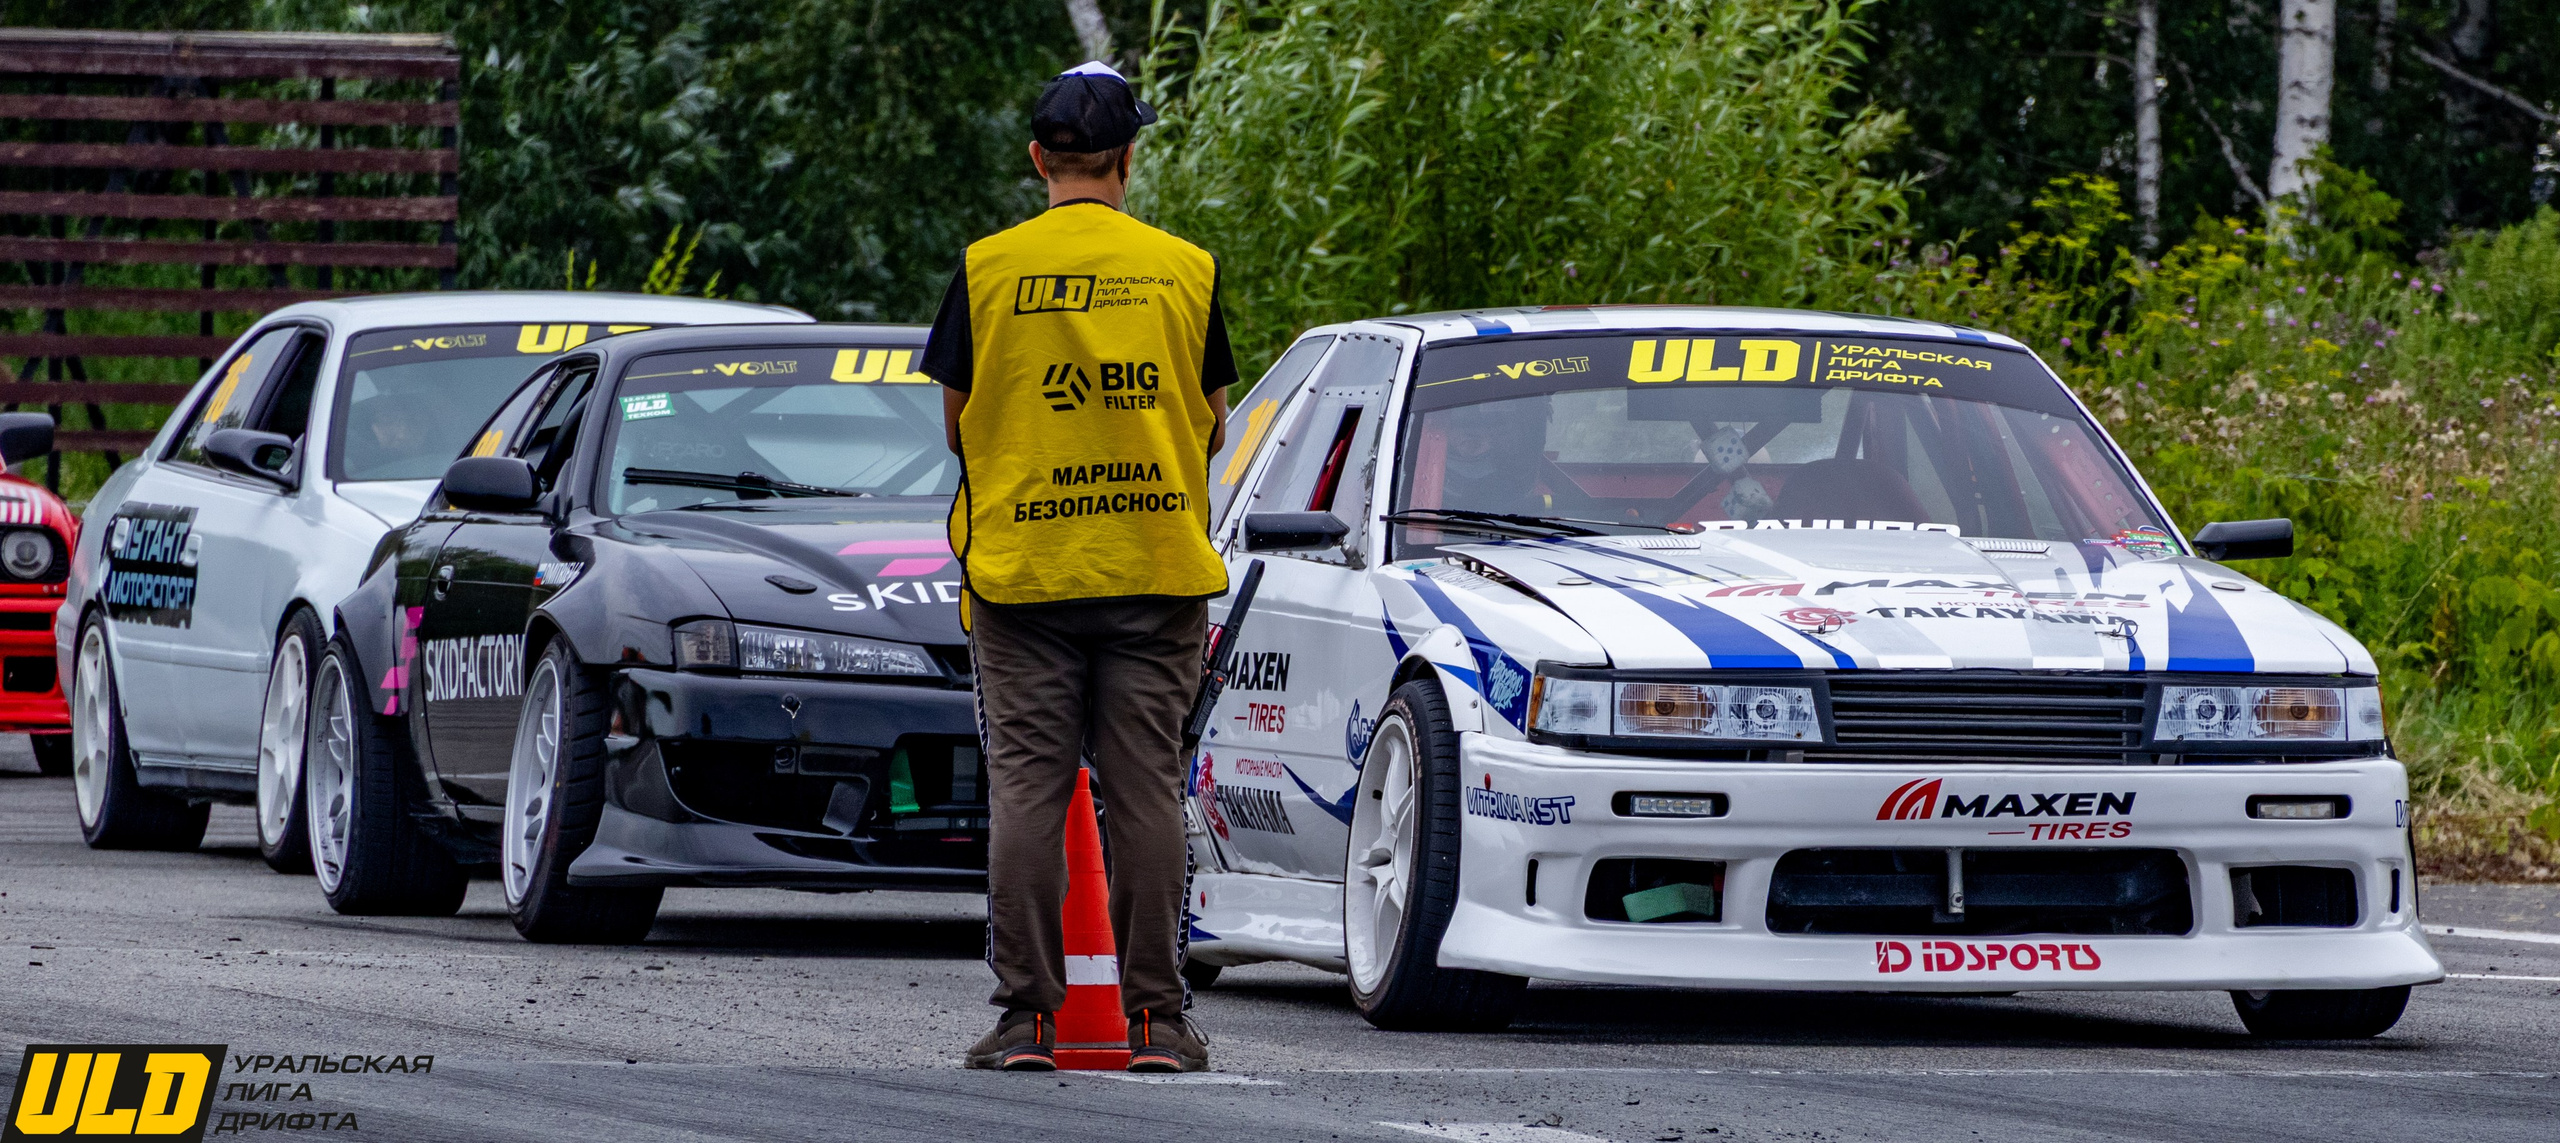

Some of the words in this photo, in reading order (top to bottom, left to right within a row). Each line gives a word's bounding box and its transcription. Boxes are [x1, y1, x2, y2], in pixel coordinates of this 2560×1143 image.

[1096, 288, 1130, 297] ЛИГА
[1099, 276, 1174, 287] УРАЛЬСКАЯ
[1018, 277, 1091, 312] ULD
[1093, 297, 1149, 310] ДРИФТА
[412, 333, 488, 351] VOLT
[830, 349, 943, 384] UL
[1497, 356, 1589, 379] VOLT
[1628, 339, 1801, 383] ULD
[1828, 357, 1902, 371] ЛИГА
[1830, 344, 1993, 371] УРАЛЬСКАЯ
[714, 361, 797, 377] VOLT
[1100, 362, 1159, 391] BIG
[1826, 369, 1944, 388] ДРИФТА
[626, 399, 668, 413] ULD
[1104, 395, 1156, 410] FILTER
[1220, 398, 1279, 486] 10
[1052, 462, 1163, 487] МАРШАЛ
[108, 570, 194, 611] МОТОРСПОРТ
[1815, 579, 2147, 601] MAXEN
[1973, 590, 2151, 608] TIRES
[1866, 607, 2136, 625] TAKAYAMA
[426, 634, 525, 702] SKIDFACTORY
[1248, 702, 1286, 733] TIRES
[1235, 758, 1264, 777] МОТОРНЫЕ
[1264, 761, 1283, 778] МАСЛА
[1215, 783, 1295, 835] TAKAYAMA
[1466, 786, 1526, 823] VITRINA
[1524, 795, 1575, 825] KST
[1941, 792, 2137, 818] MAXEN
[2028, 822, 2133, 840] TIRES
